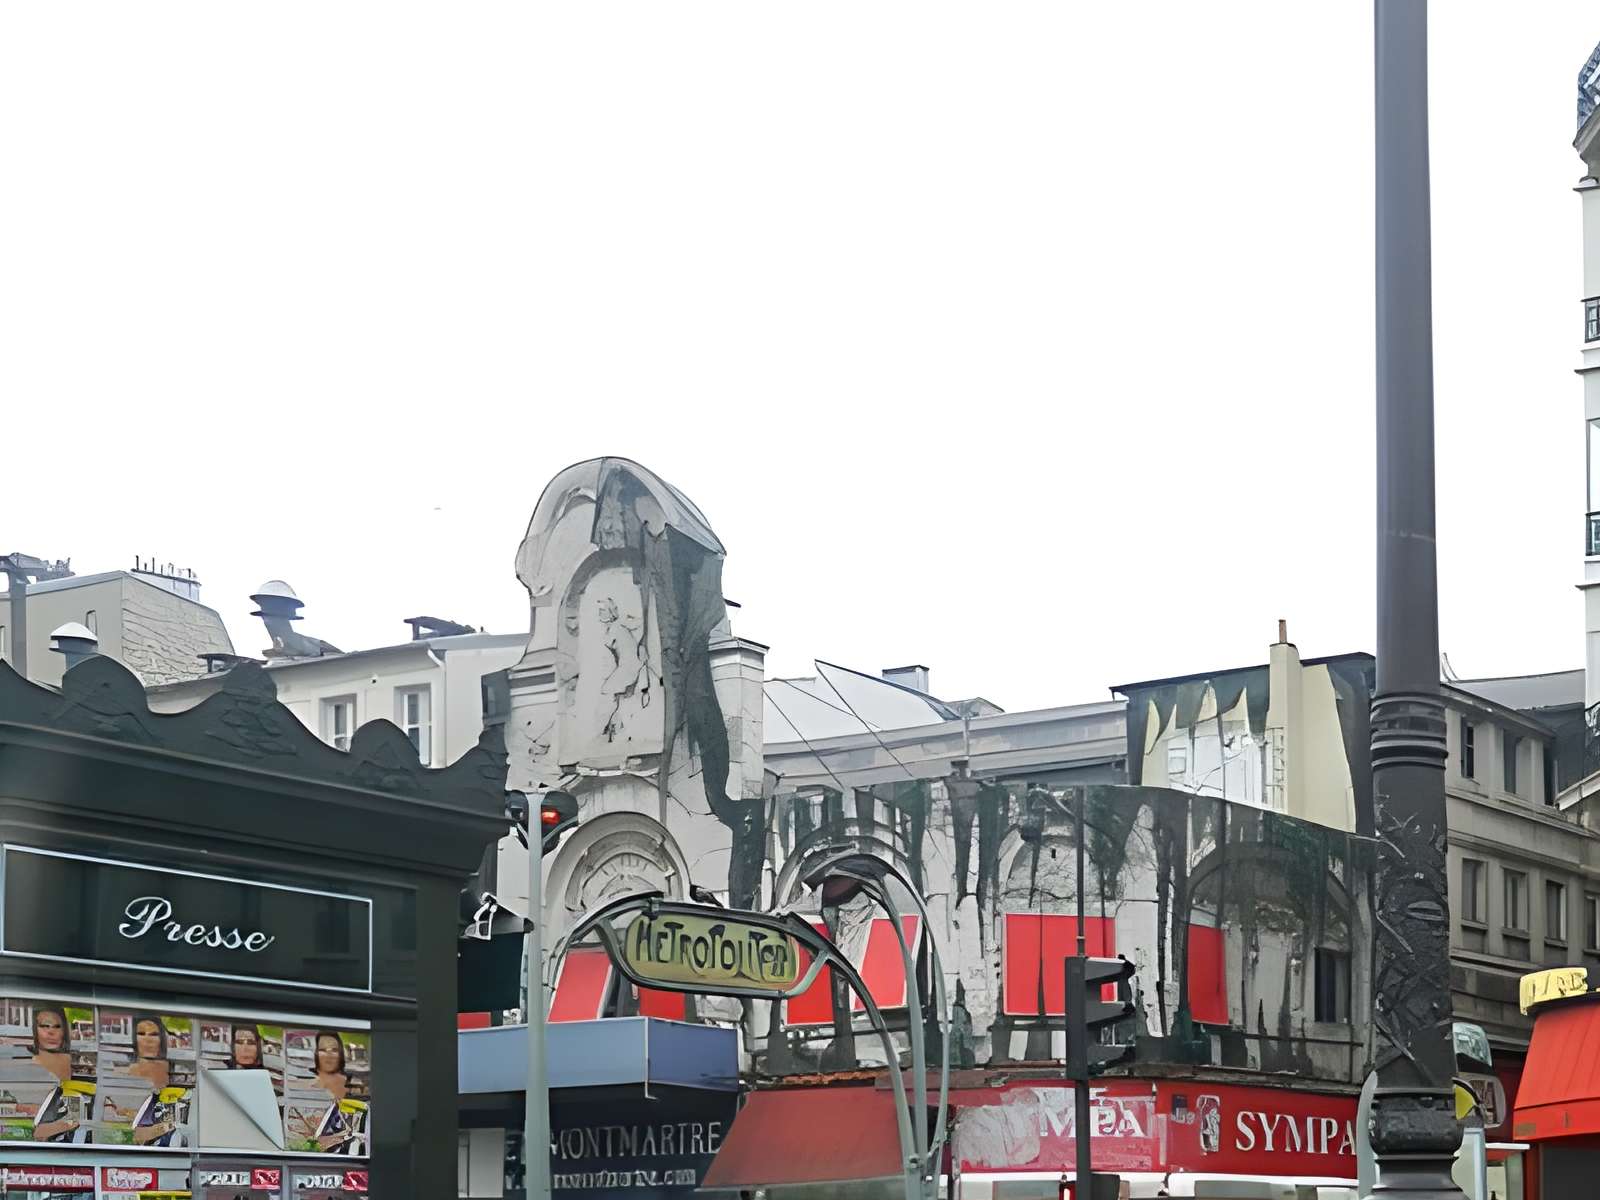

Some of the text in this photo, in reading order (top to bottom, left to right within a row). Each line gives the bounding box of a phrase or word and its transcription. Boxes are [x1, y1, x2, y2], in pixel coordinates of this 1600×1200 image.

[117, 895, 276, 952] Presse
[549, 1121, 721, 1160] MONTMARTRE
[1235, 1110, 1356, 1156] SYMPA
